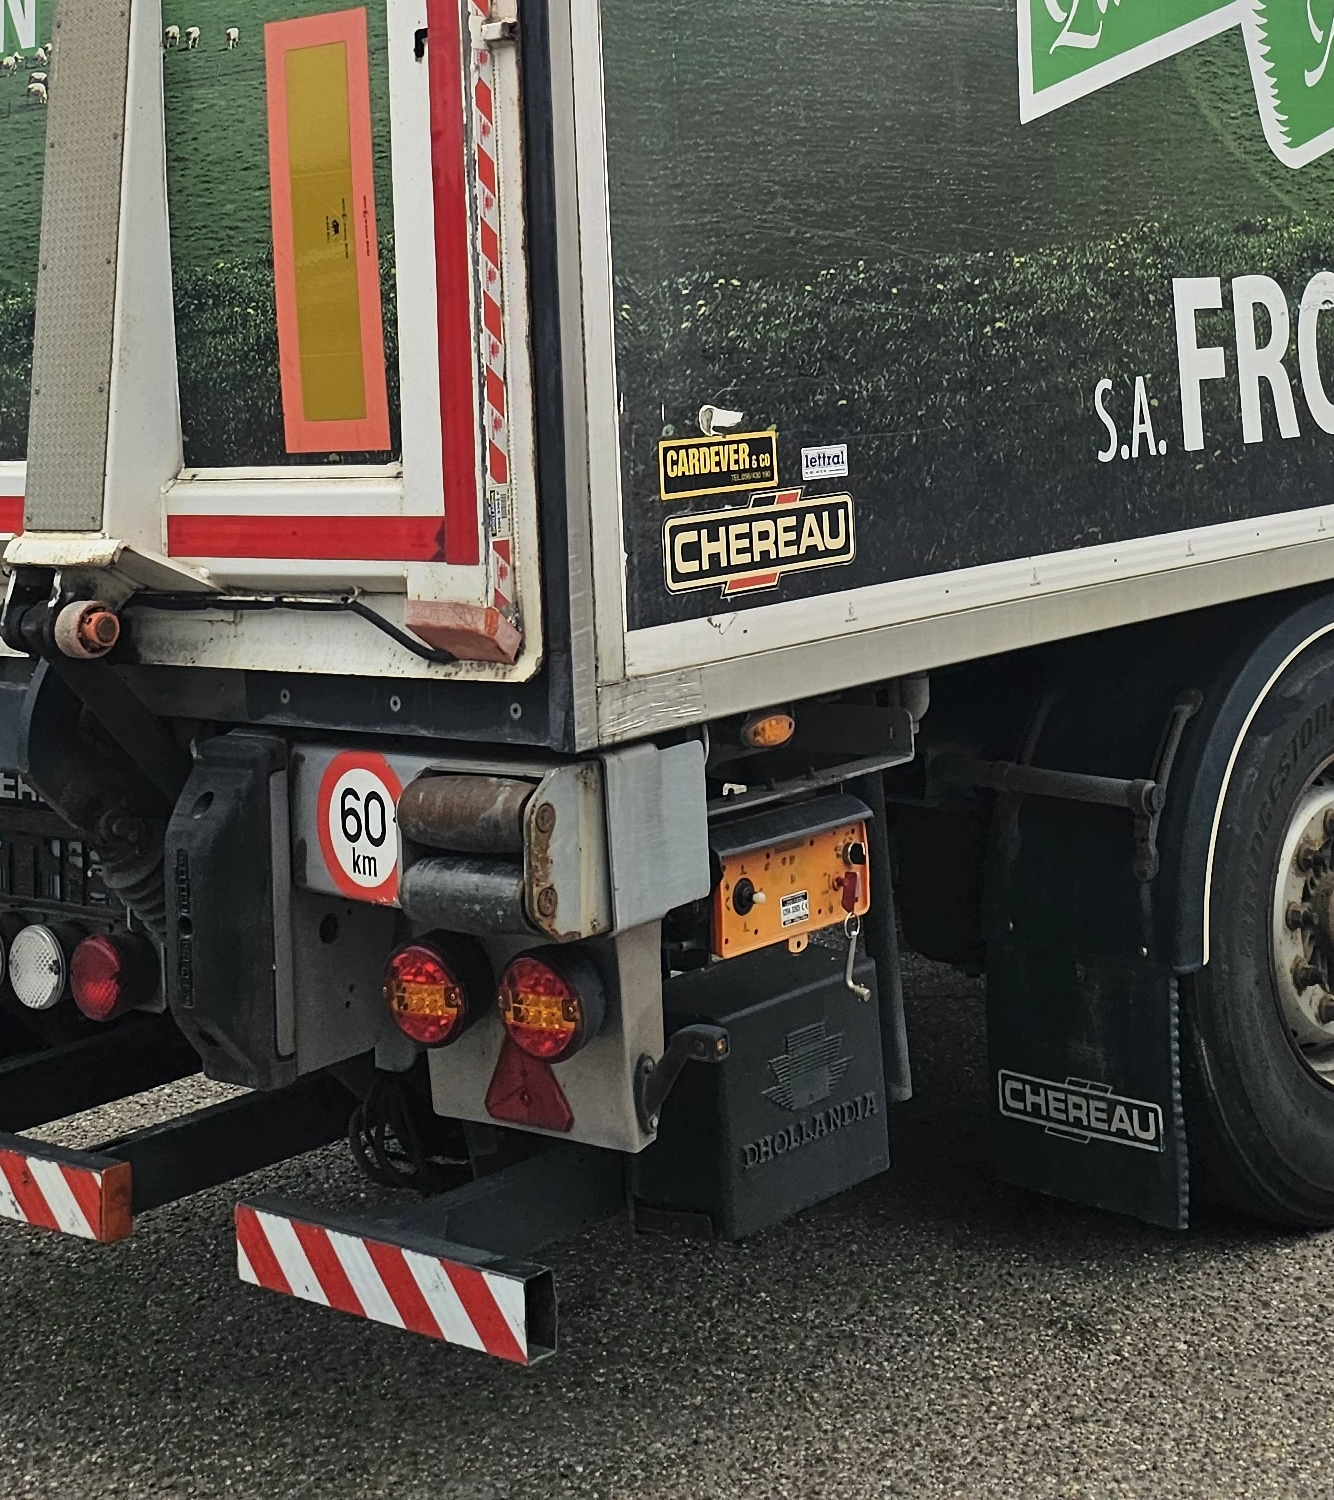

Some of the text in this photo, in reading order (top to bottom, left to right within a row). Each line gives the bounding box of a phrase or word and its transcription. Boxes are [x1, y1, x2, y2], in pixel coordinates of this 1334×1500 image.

[1095, 375, 1167, 463] S.A.
[667, 443, 771, 477] CARDEVER & CO
[805, 450, 845, 468] lettral
[674, 508, 846, 574] CHEREAU
[340, 787, 387, 847] 60
[352, 847, 378, 878] km
[742, 1090, 879, 1170] DHOLLANDIA
[1005, 1079, 1156, 1141] CHEREAU
